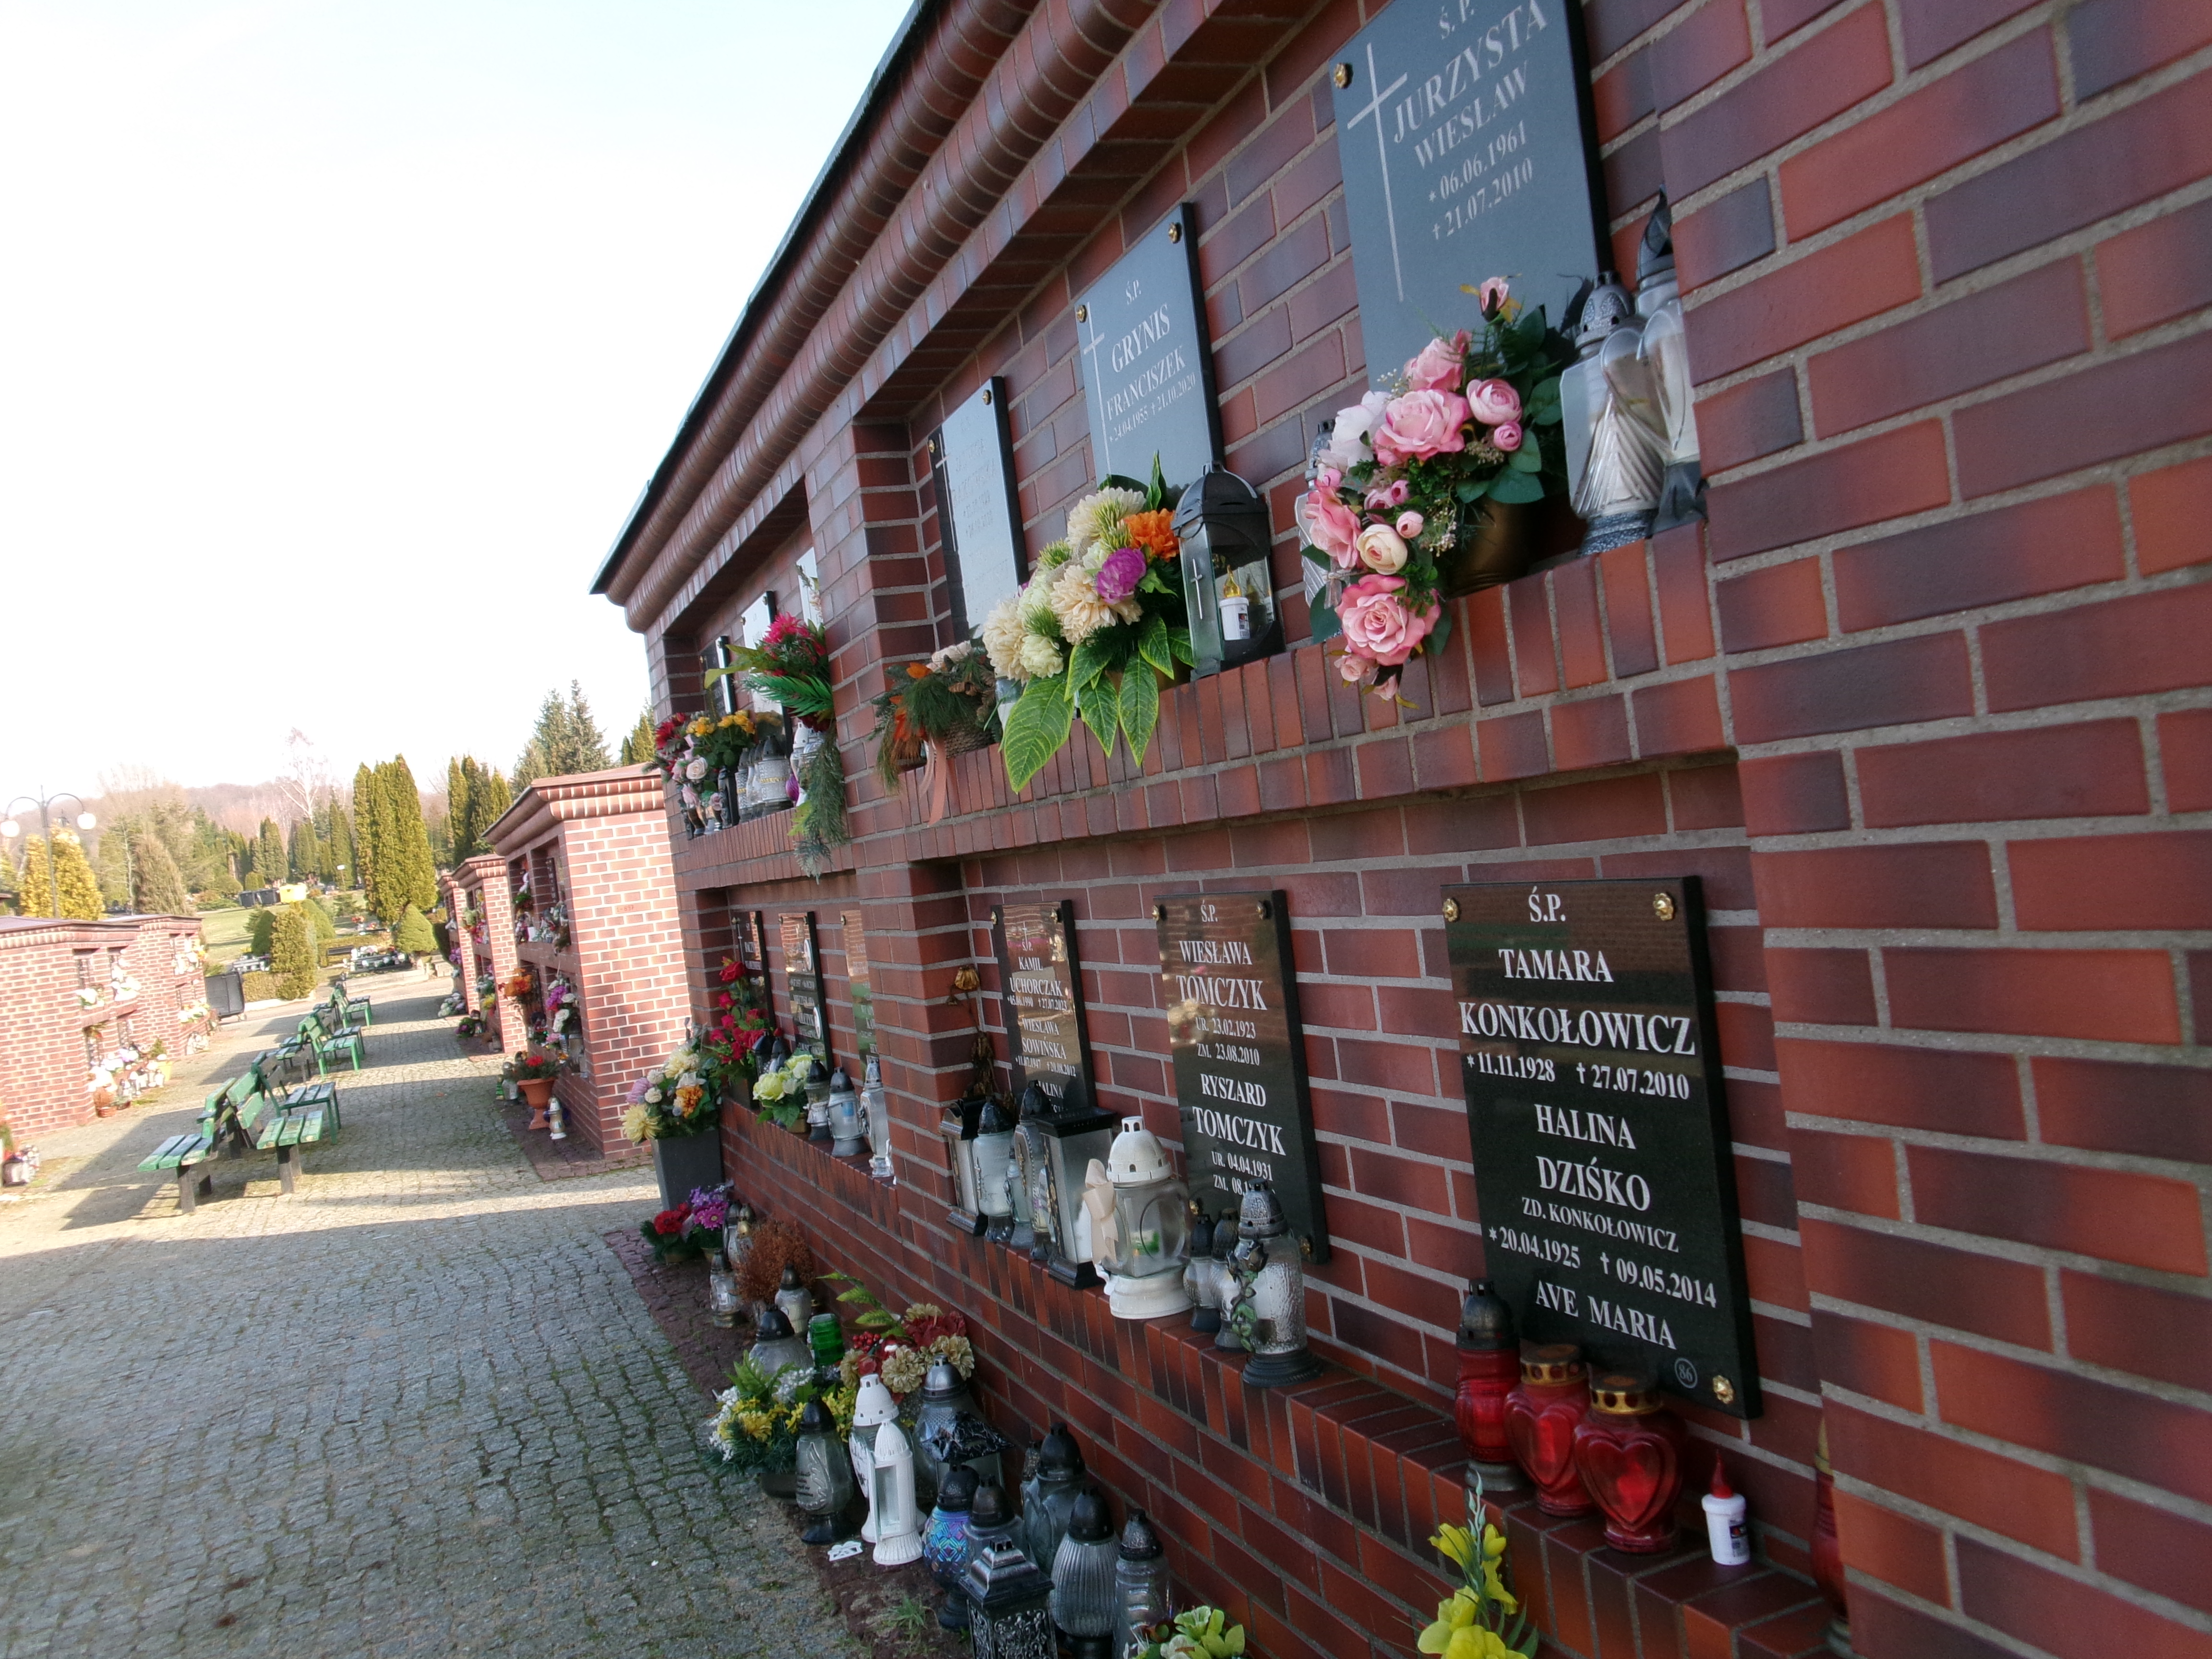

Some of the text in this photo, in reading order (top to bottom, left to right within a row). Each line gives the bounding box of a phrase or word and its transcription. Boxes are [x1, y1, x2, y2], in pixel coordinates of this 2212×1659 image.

[1394, 0, 1547, 143] JURZYSTA
[1111, 302, 1170, 373] GRYNIS
[1106, 345, 1186, 421] FRANCISZEK
[1200, 899, 1218, 923] Ś.P.
[1528, 886, 1566, 922] Ś.P.
[1018, 956, 1044, 971] KAMIL
[1178, 939, 1253, 965] WIESŁAWA
[1498, 949, 1614, 983] TAMARA
[1009, 977, 1063, 997] UCHORCZAK
[1176, 974, 1268, 1010] TOMCZYK
[1195, 1016, 1257, 1039] UR. 23.02.1923
[1458, 1001, 1696, 1056] KONKOŁOWICZ
[1022, 1036, 1067, 1059] SOWIŃSKA
[1196, 1042, 1260, 1066] ZM. 23.08.2010
[1200, 1073, 1267, 1107] RYSZARD
[1477, 1051, 1690, 1100] 11.11.1928 27.07.2010
[1191, 1106, 1286, 1156] TOMCZYK
[1534, 1104, 1637, 1150] HALINA
[1211, 1151, 1273, 1181] UR. 04.04.1931
[1213, 1174, 1229, 1191] ZM.
[1535, 1156, 1651, 1211] DZIŚKO
[1521, 1197, 1679, 1253] ZD. KONKOŁOWICZ
[1499, 1226, 1717, 1309] 20.04.1925 09.05.2014
[1535, 1280, 1677, 1350] AVE MARIA
